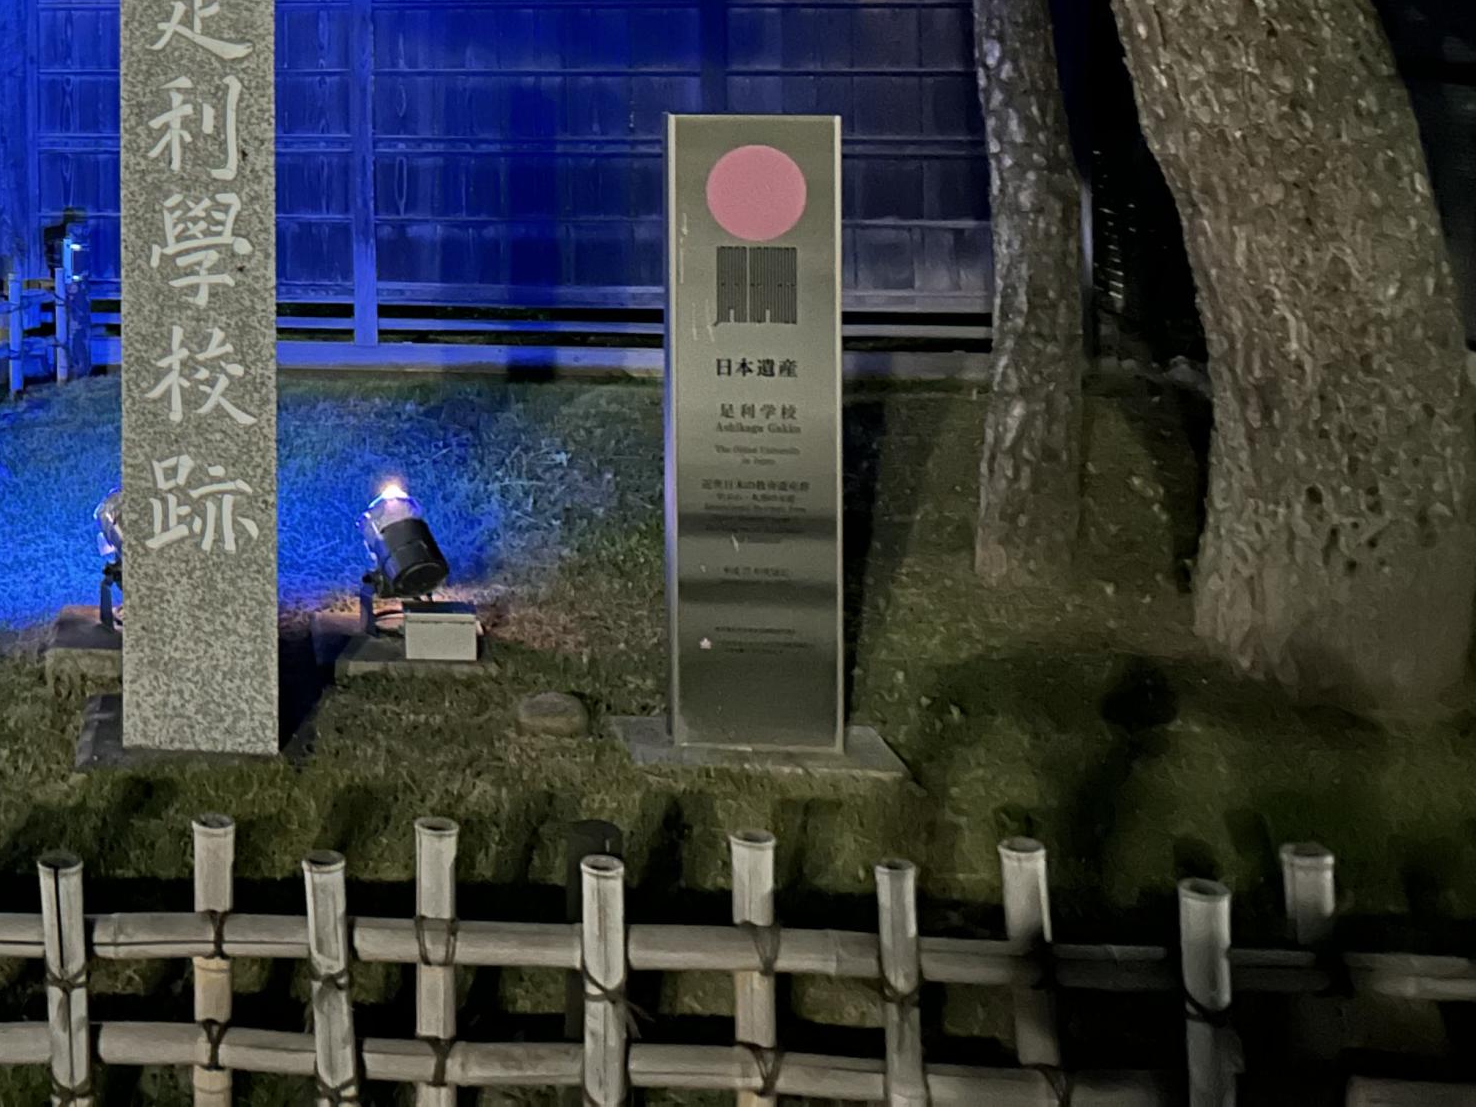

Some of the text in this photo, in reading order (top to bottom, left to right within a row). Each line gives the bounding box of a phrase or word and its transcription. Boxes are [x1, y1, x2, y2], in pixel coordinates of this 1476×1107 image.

[716, 358, 798, 377] 日本遺産
[720, 403, 797, 420] 足利学校
